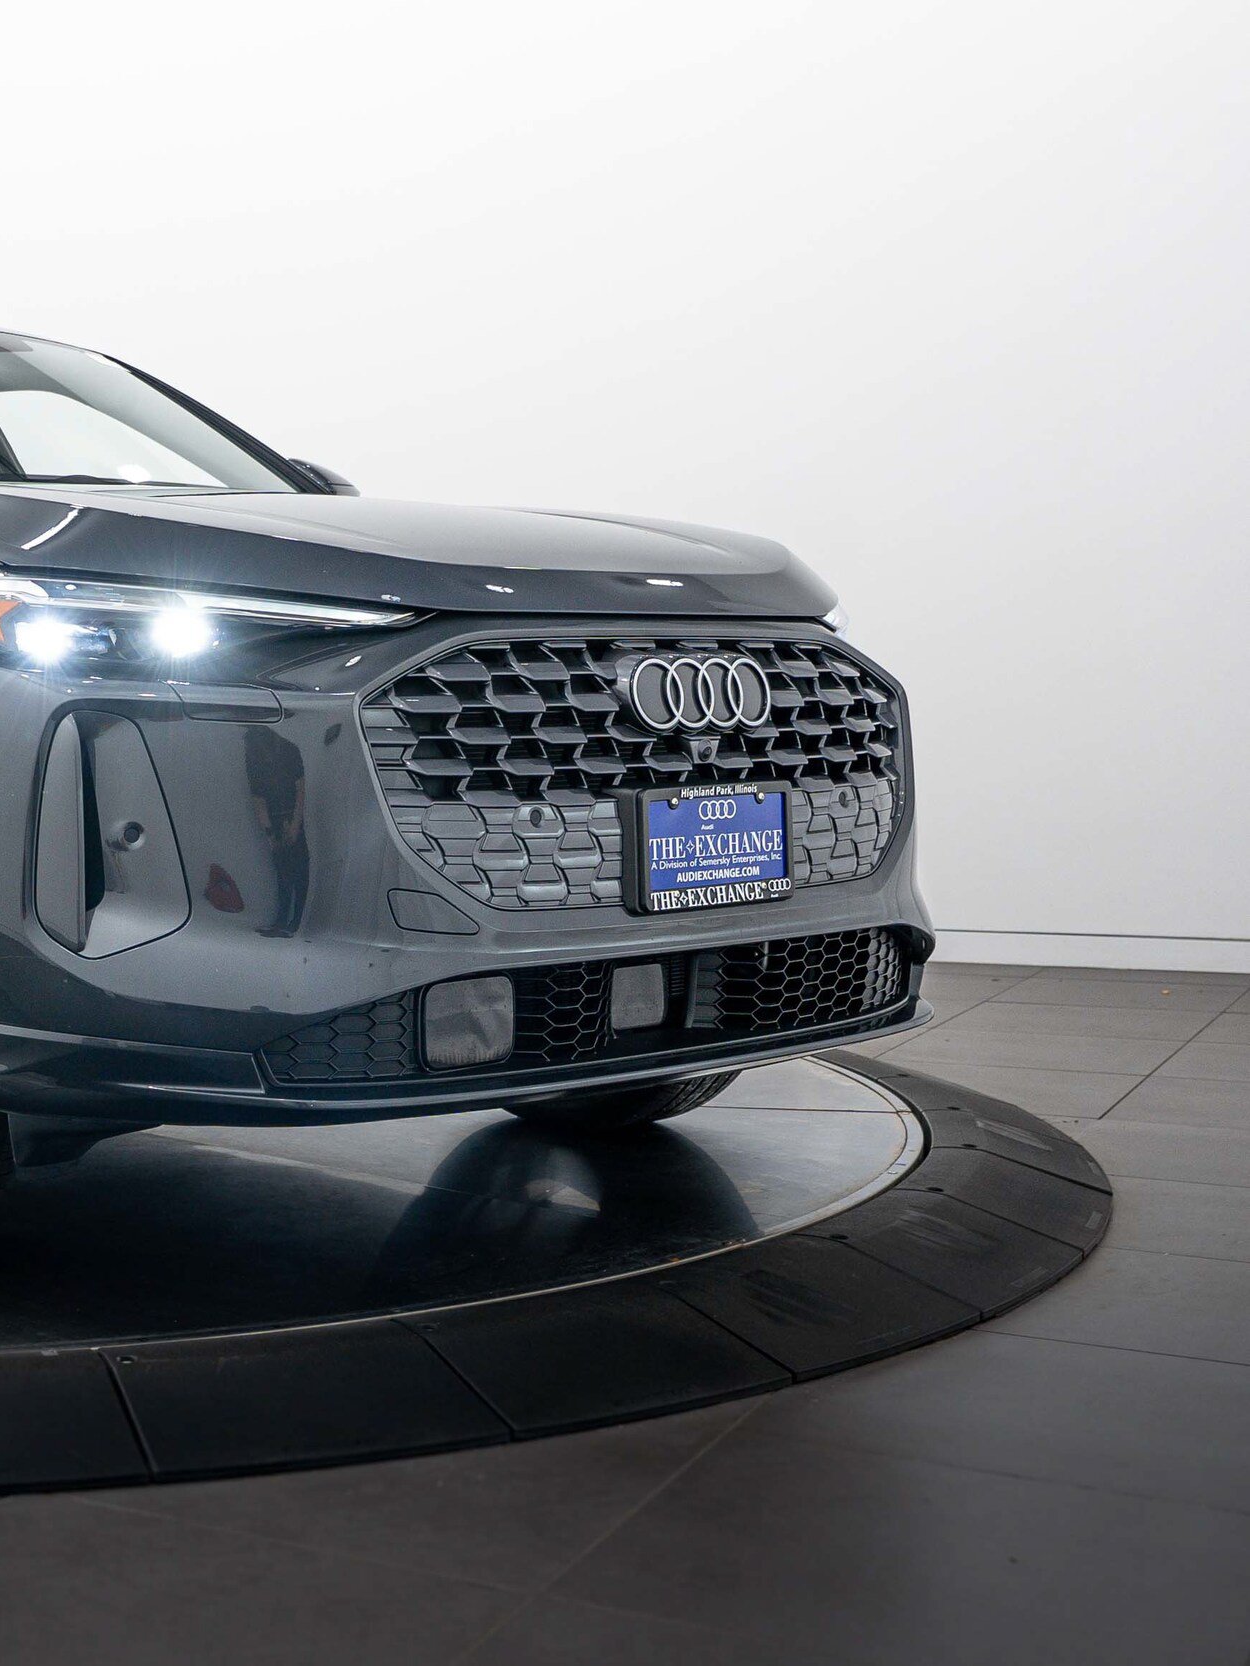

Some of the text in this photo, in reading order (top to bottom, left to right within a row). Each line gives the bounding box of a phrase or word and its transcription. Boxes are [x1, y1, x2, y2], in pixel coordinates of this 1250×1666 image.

[680, 783, 758, 800] Highland Park, Illinois
[700, 823, 715, 831] Audi
[648, 830, 783, 861] THE EXCHANGE
[651, 861, 658, 870] A
[659, 860, 688, 870] Division
[690, 858, 698, 867] of
[698, 855, 731, 867] Semersky
[732, 853, 770, 865] Enterprises,
[676, 865, 761, 883] AUDIEXCHANGE.COM
[650, 881, 765, 912] THE EXCHANGE
